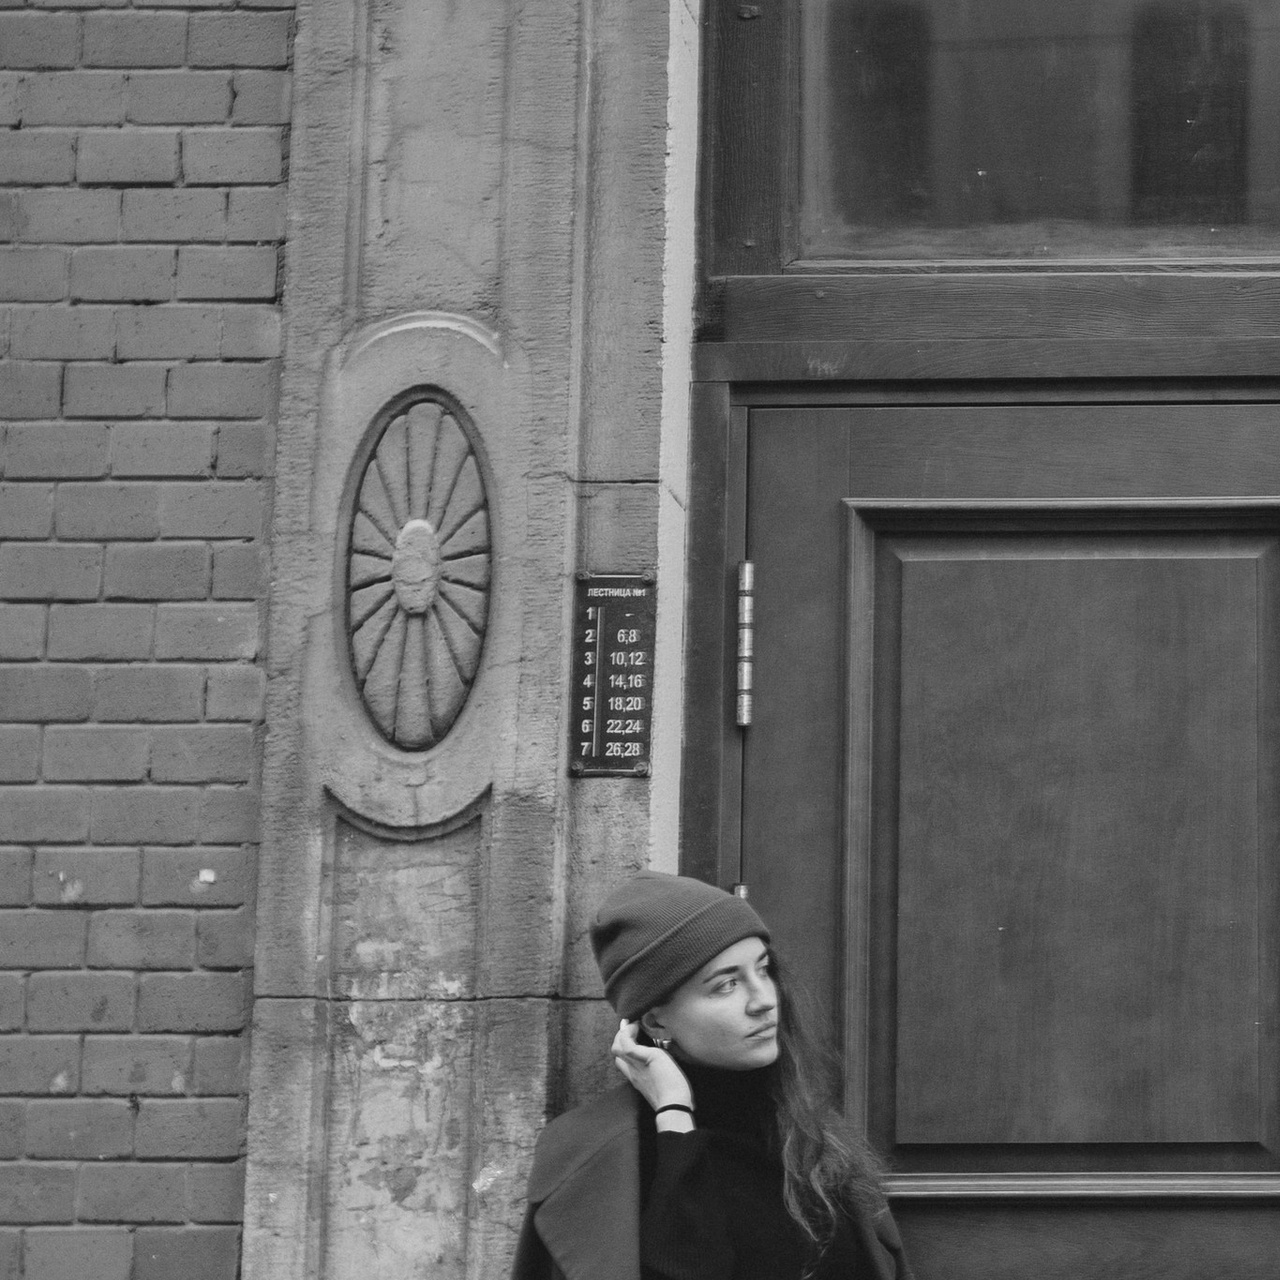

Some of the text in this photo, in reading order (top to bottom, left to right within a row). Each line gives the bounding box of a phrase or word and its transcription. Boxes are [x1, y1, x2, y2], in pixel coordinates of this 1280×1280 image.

[588, 588, 630, 598] ЛЕСТНИЦА
[587, 607, 594, 620] 1
[585, 629, 637, 644] 2 6,8
[585, 652, 643, 666] 3 10,12
[583, 675, 642, 689] 4 14,16
[583, 697, 641, 711] 5 18,20
[582, 720, 640, 734] 6 22,24
[581, 743, 639, 757] 7 26,28
